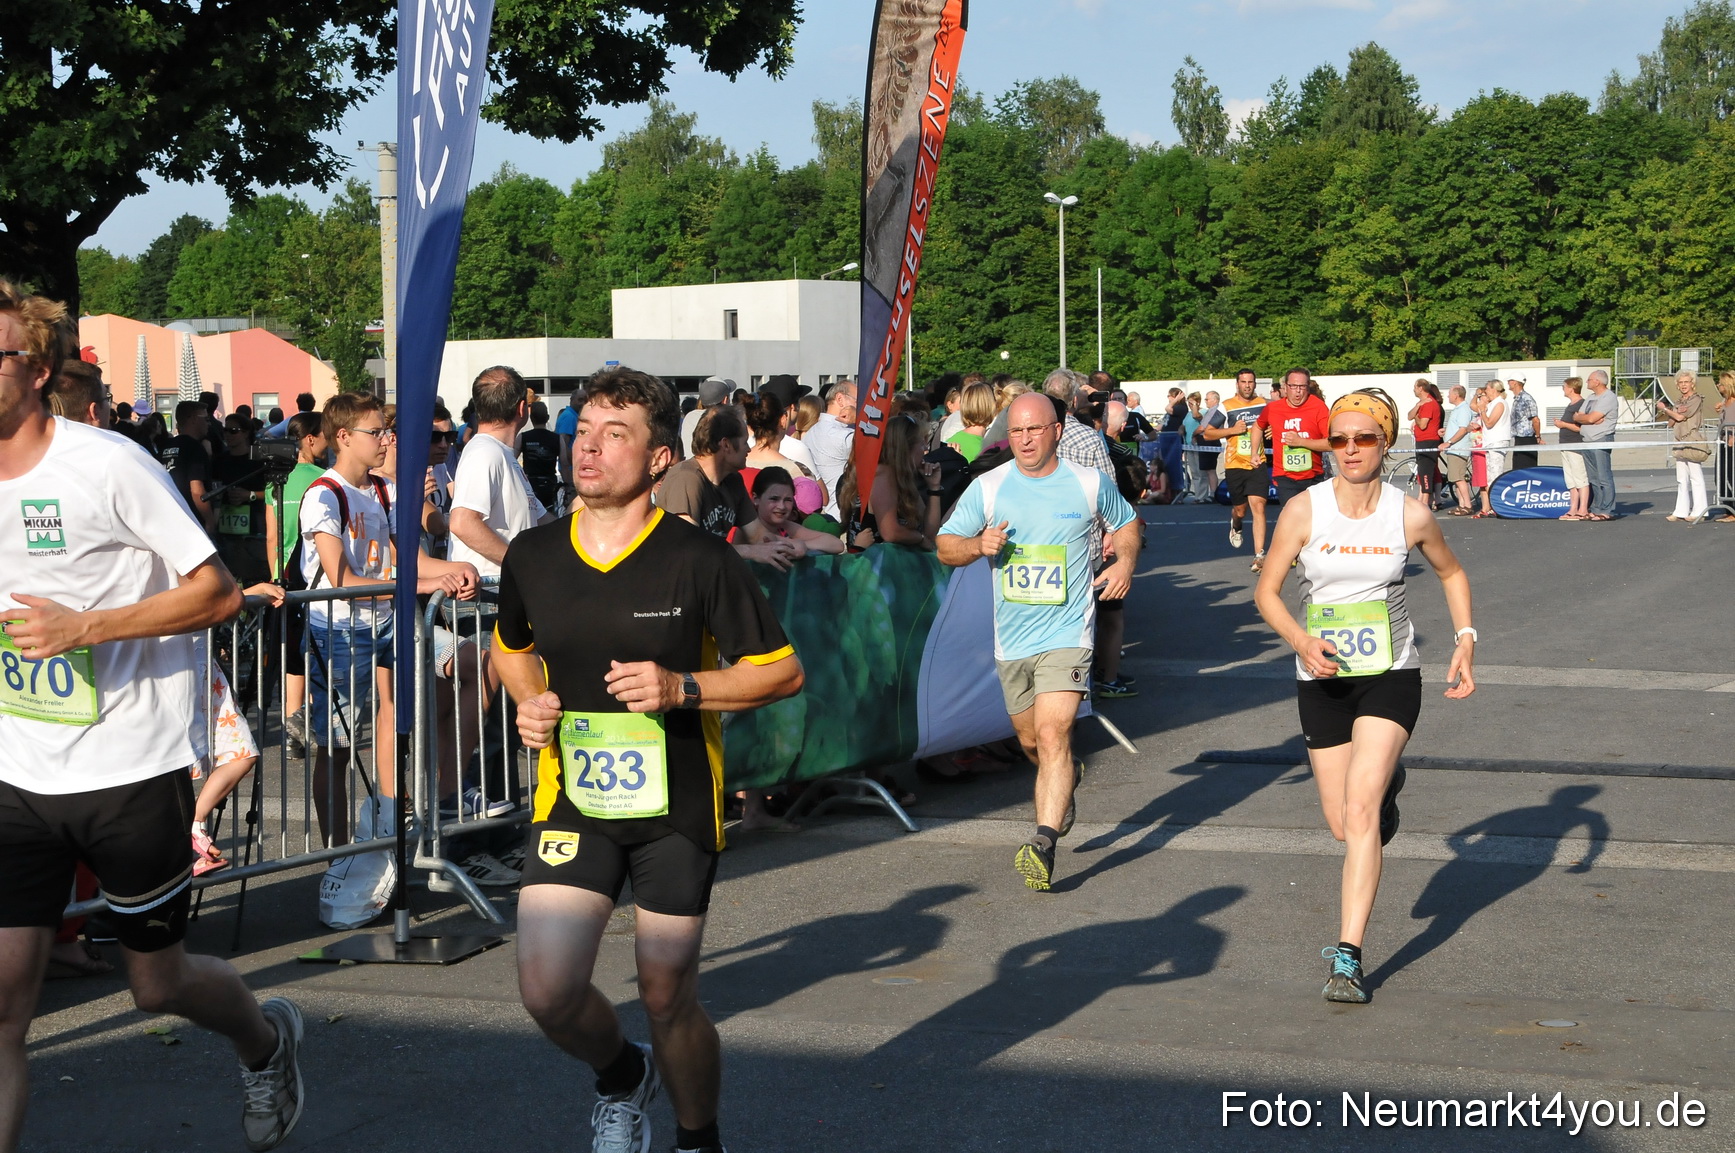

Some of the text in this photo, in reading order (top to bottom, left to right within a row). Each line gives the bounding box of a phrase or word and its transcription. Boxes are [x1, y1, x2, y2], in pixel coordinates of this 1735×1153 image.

[1286, 454, 1306, 465] 851
[23, 518, 63, 529] MICKAN
[220, 515, 249, 527] 1179
[28, 548, 68, 557] meisterhaft
[1340, 546, 1394, 555] KLEBL
[1004, 564, 1063, 590] 1374
[1320, 627, 1377, 658] 536
[1, 650, 75, 698] 870
[19, 694, 43, 706] Alexander
[573, 749, 647, 792] 233
[588, 801, 607, 809] Deutsche
[542, 841, 574, 857] FC
